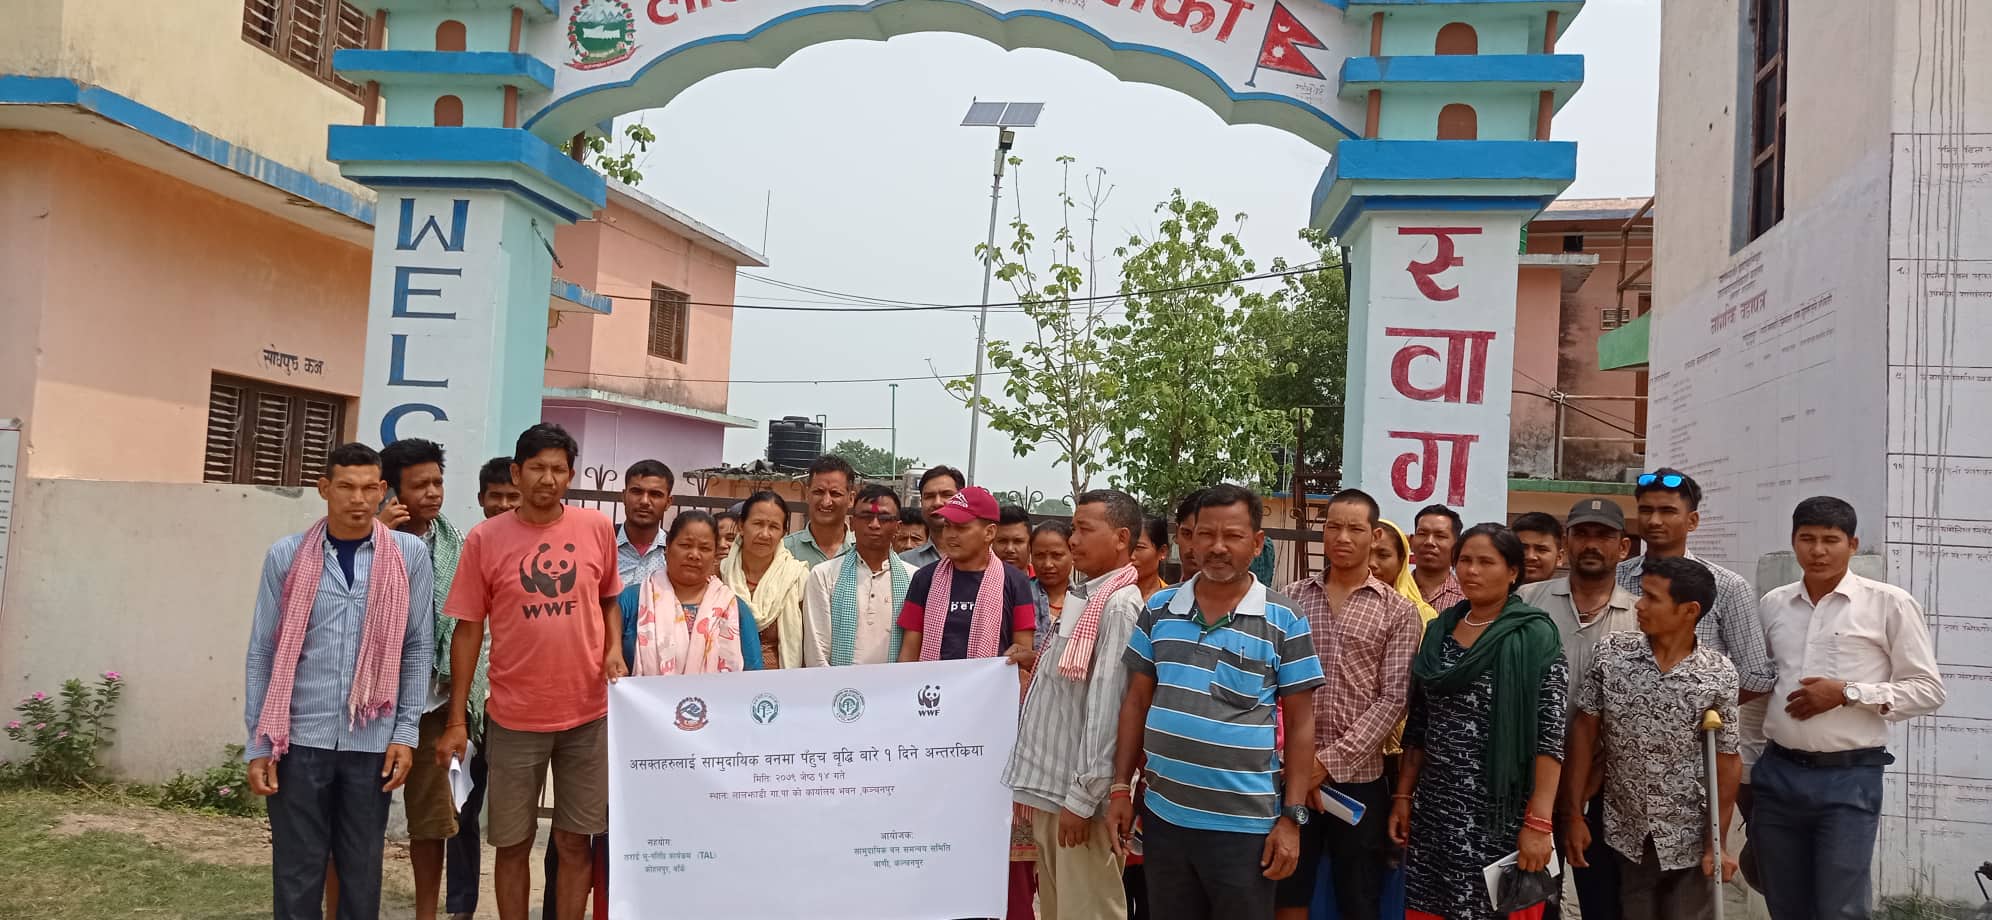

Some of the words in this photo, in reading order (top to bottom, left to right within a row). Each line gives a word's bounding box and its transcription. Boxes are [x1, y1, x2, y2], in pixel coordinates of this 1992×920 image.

[522, 600, 577, 619] WWF
[918, 709, 941, 717] WWF
[701, 752, 760, 771] सामुदायिक
[765, 753, 795, 767] वनमा
[884, 748, 892, 761] १
[898, 744, 919, 760] दिने
[818, 771, 830, 781] १४
[833, 769, 846, 780] गते
